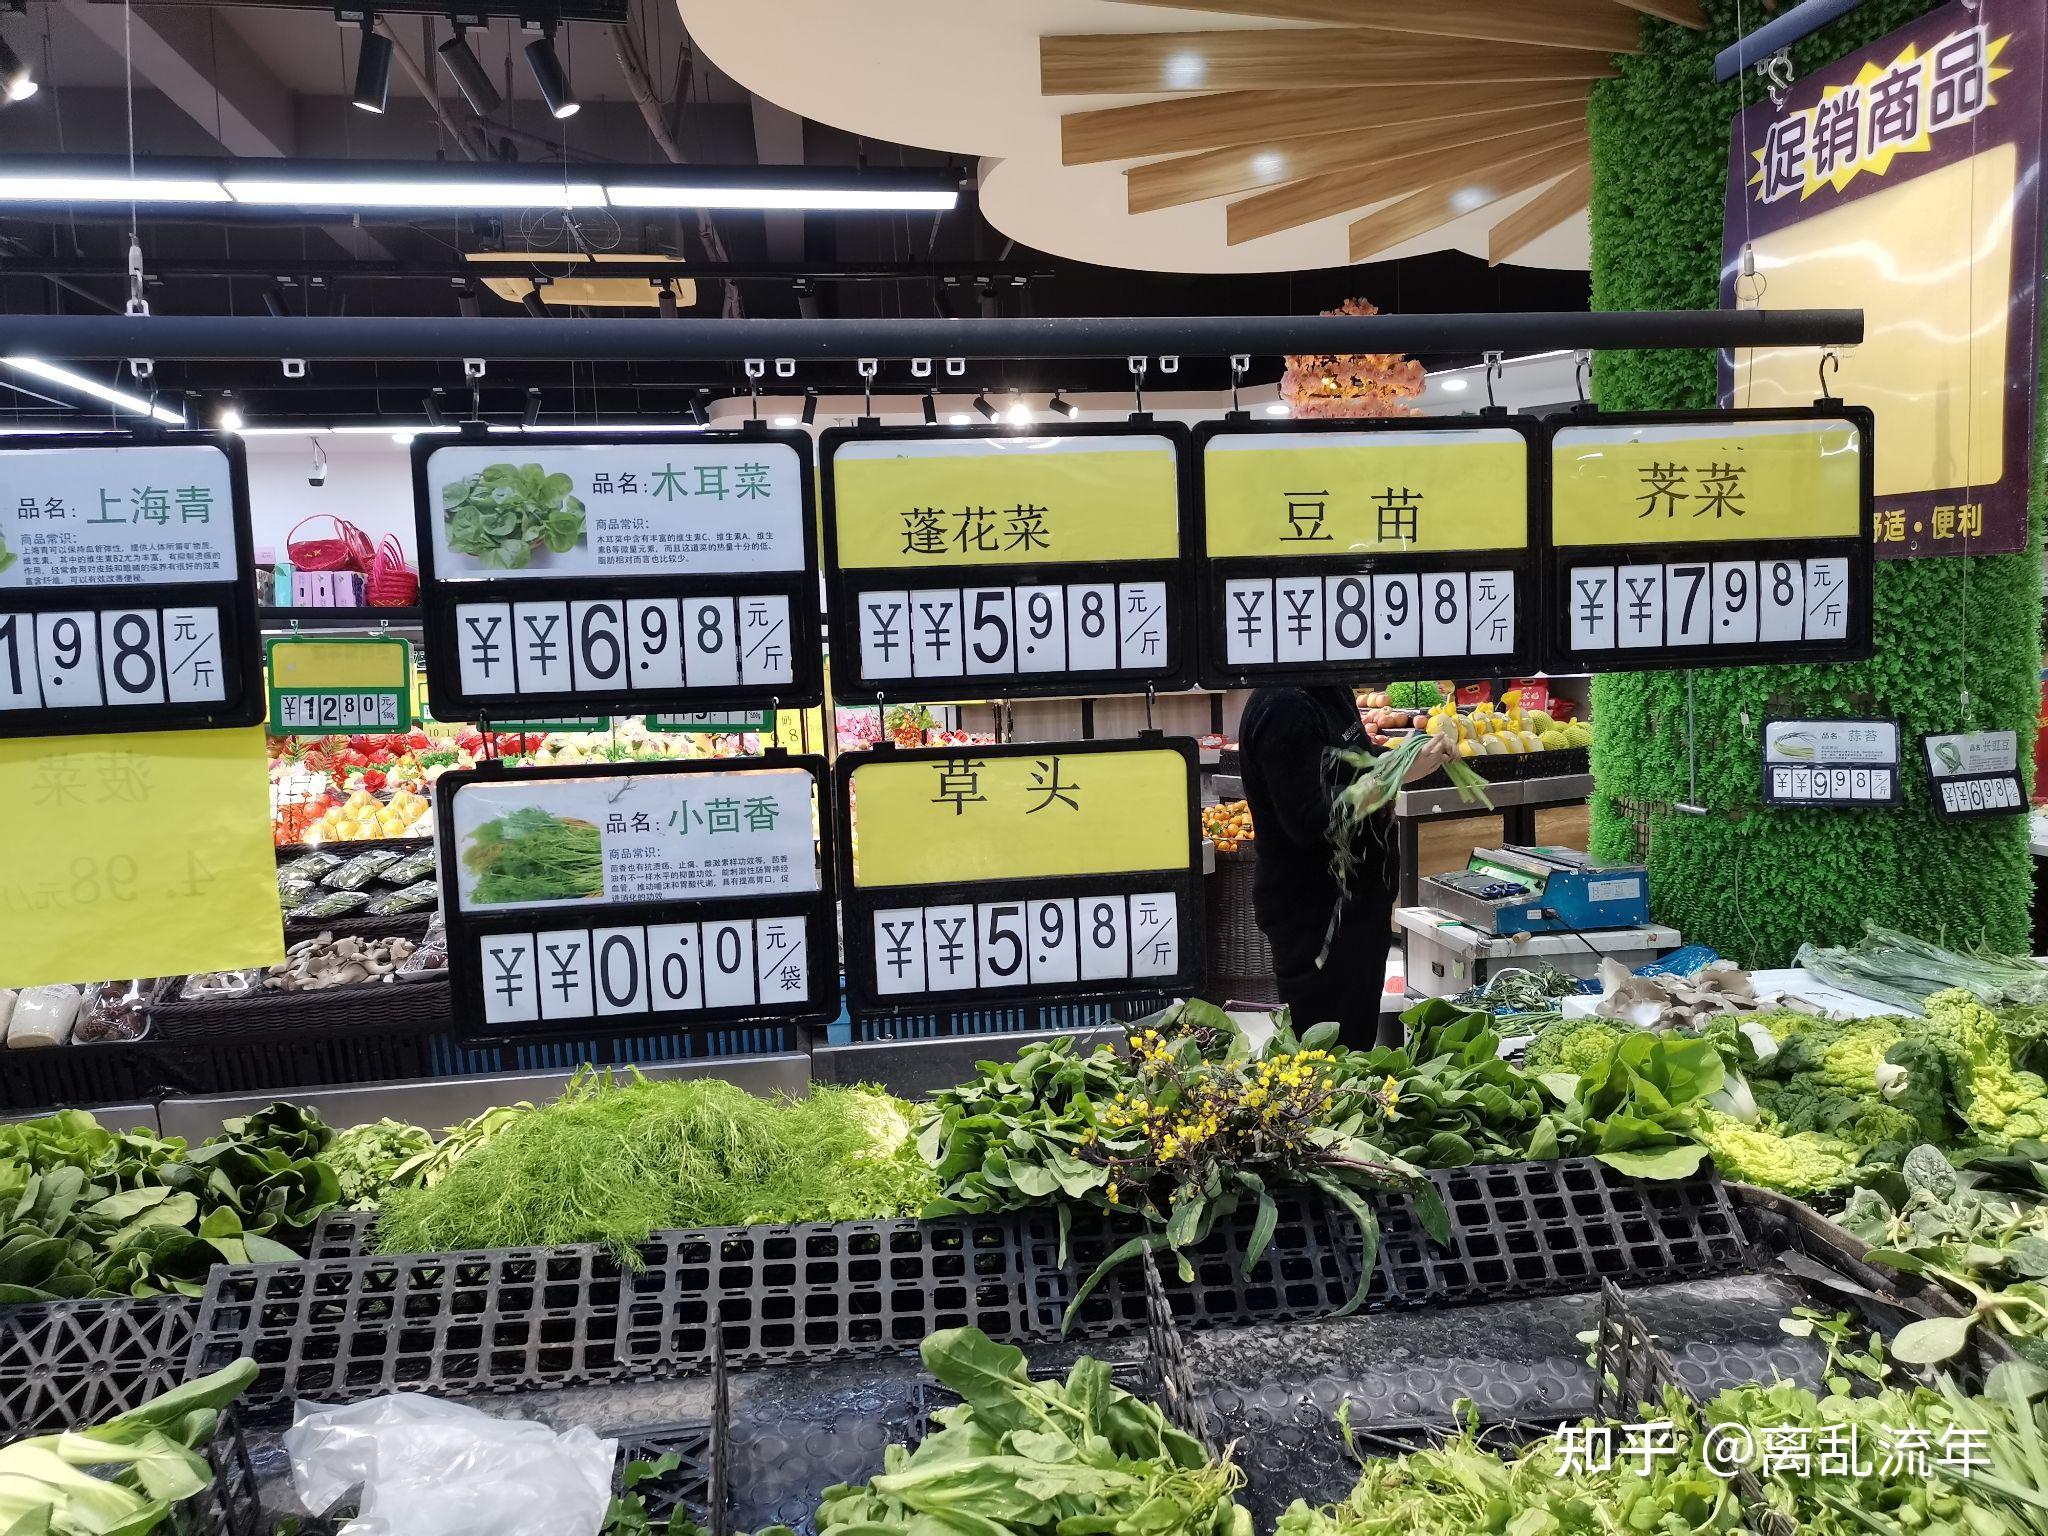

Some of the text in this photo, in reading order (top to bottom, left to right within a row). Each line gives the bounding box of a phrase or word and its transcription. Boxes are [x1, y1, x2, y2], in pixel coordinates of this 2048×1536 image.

[1763, 28, 1986, 202] 促销商品
[87, 485, 214, 525] 上海青
[652, 463, 771, 501] 木耳菜
[1636, 461, 1747, 518] 荠菜
[900, 504, 1051, 555] 蓬花菜
[668, 795, 780, 836] 小茴香
